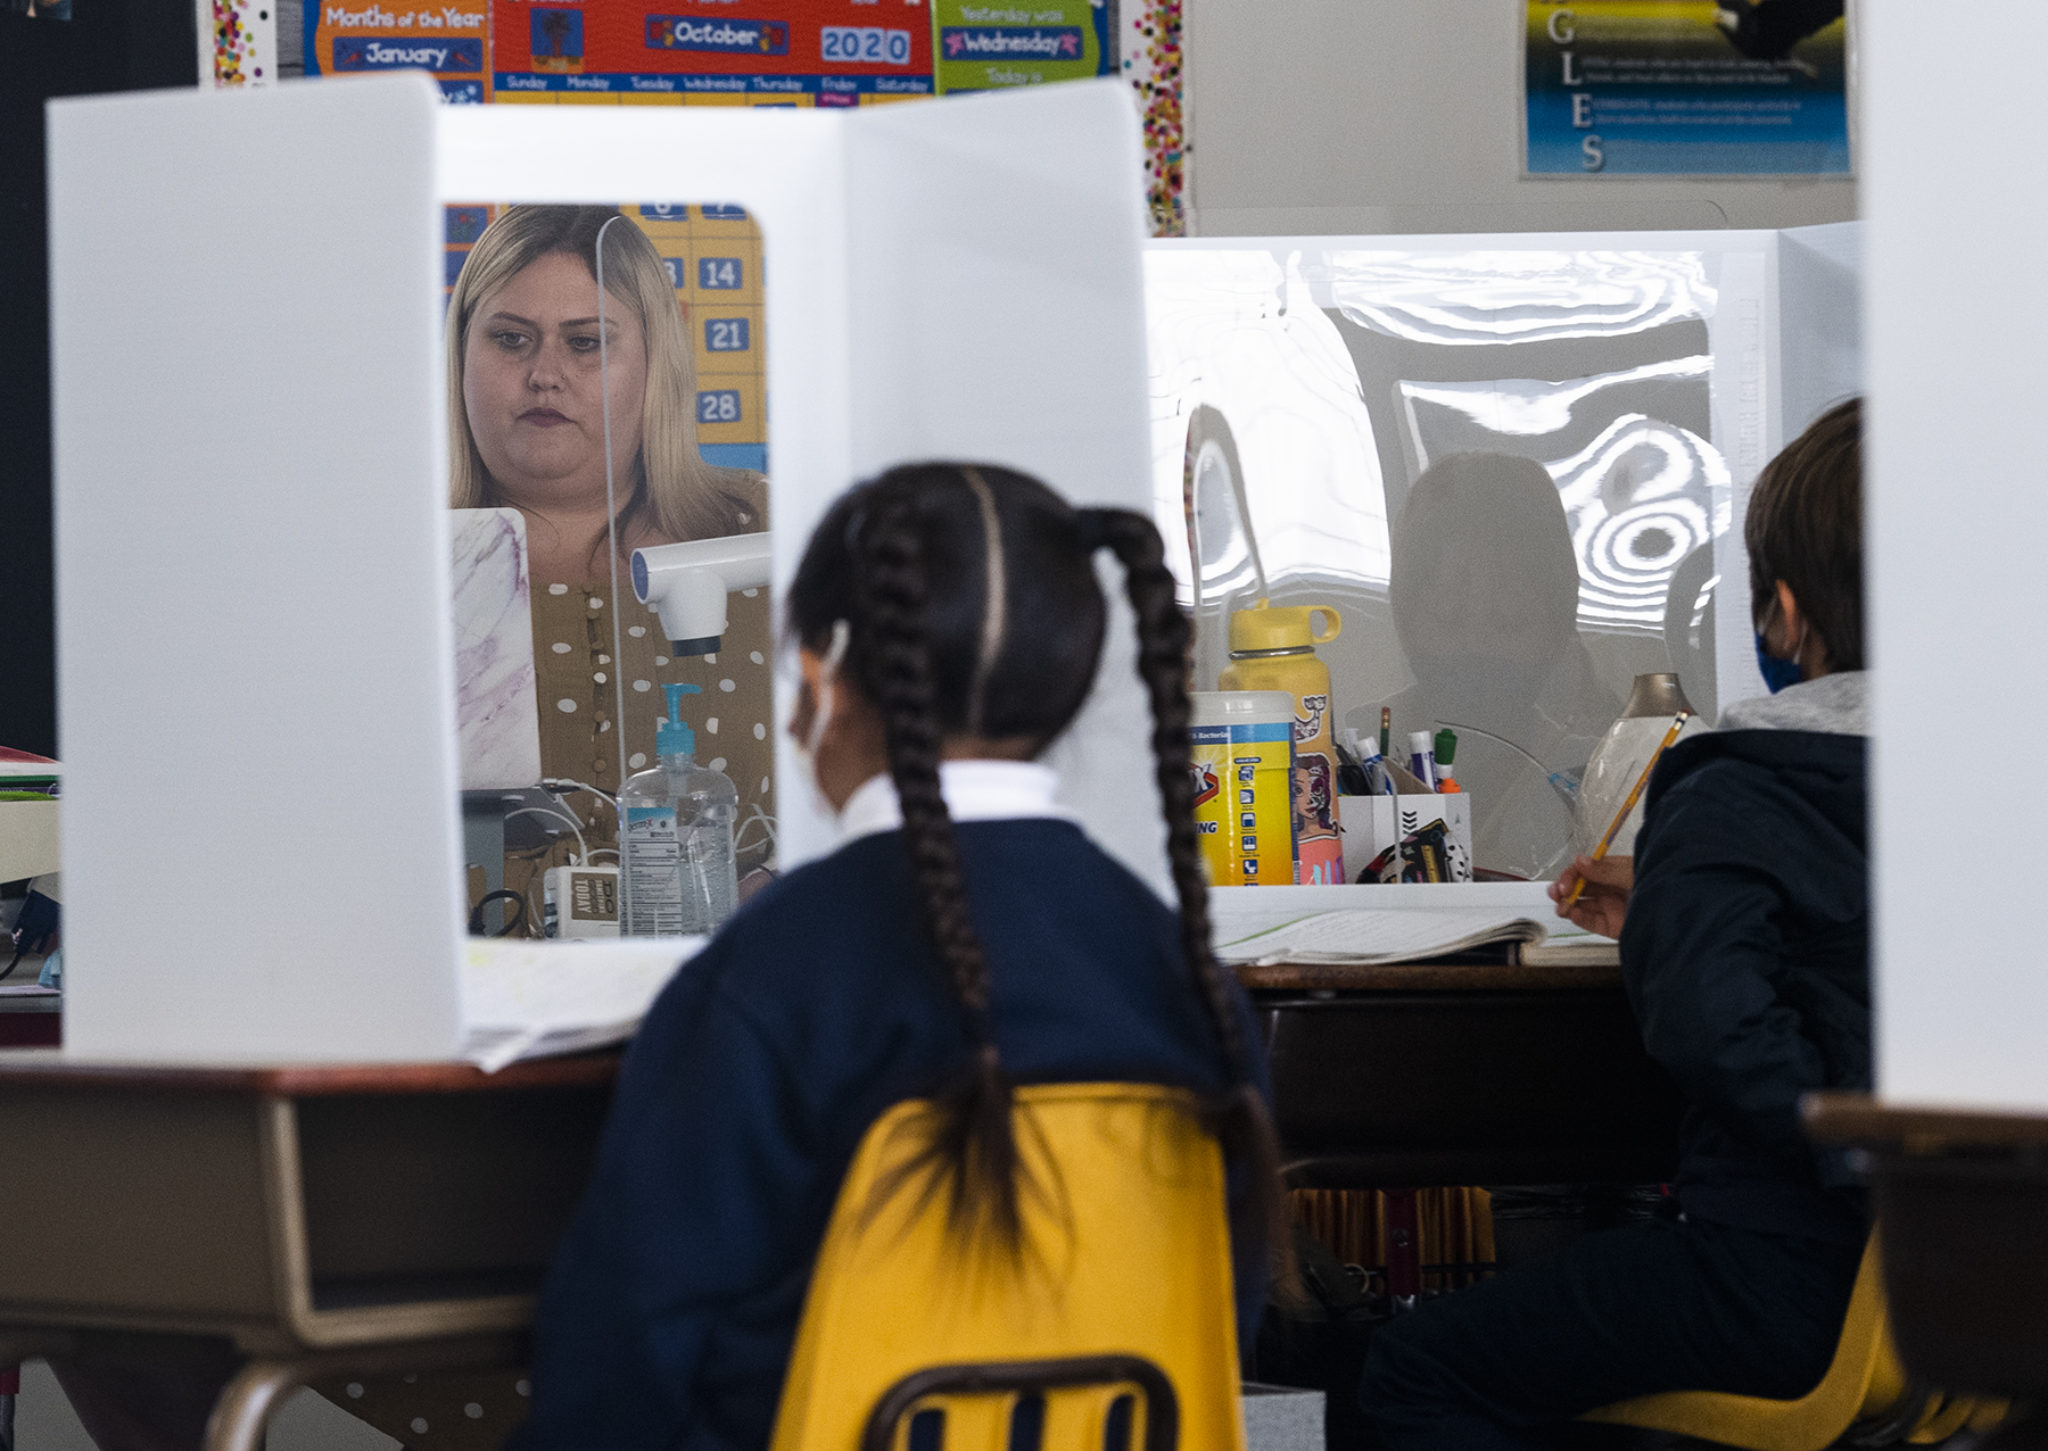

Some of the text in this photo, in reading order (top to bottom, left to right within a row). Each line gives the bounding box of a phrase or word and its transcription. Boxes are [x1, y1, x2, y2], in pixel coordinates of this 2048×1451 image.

[326, 8, 485, 28] Months of the Year
[961, 6, 1064, 24] Yesterday was
[1548, 11, 1575, 44] G
[674, 22, 759, 46] October
[824, 32, 908, 60] 2020
[963, 30, 1061, 54] Wednesday
[366, 43, 448, 66] January
[986, 68, 1030, 85] Today
[1562, 53, 1582, 86] L
[506, 76, 929, 92] Sunday Monday Tuesday Wednesday Thursday Friday Saturday
[1572, 94, 1593, 128] E
[1582, 136, 1605, 170] S
[707, 261, 736, 287] 14
[712, 322, 742, 348] 21
[703, 394, 737, 421] 28
[574, 879, 593, 914] TODAY
